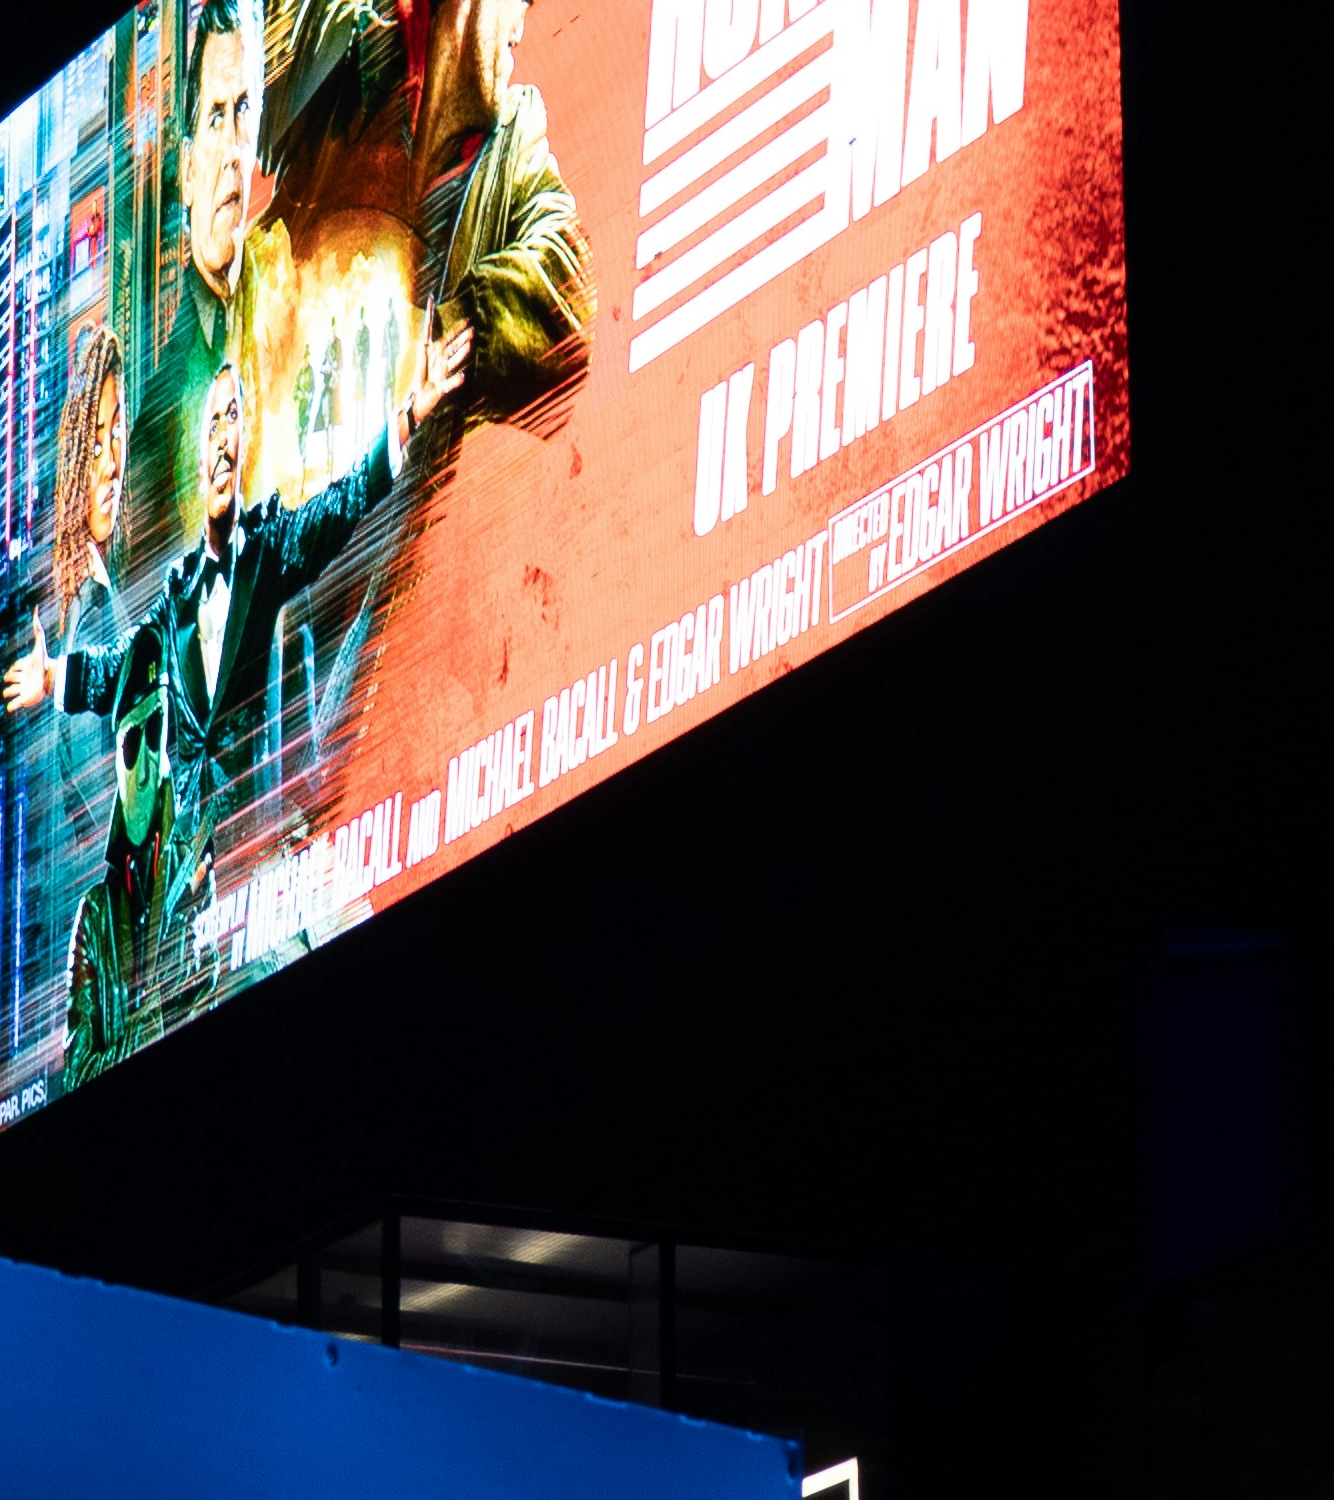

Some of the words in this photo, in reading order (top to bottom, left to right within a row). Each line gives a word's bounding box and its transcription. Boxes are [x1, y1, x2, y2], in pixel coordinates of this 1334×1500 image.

[693, 362, 756, 538] UK
[761, 211, 983, 497] PREMIERE
[832, 493, 890, 565] DIRECTED
[868, 540, 889, 593] BY
[887, 442, 973, 583] EDGAR
[979, 375, 1090, 528] WRIGHT
[332, 792, 403, 908] BACALL
[406, 790, 442, 869] AND
[445, 708, 535, 845] MICHAEL
[539, 658, 618, 785] BACALL
[622, 643, 645, 735] &
[647, 614, 726, 727] EDGAR
[728, 529, 828, 679] WRIGHT
